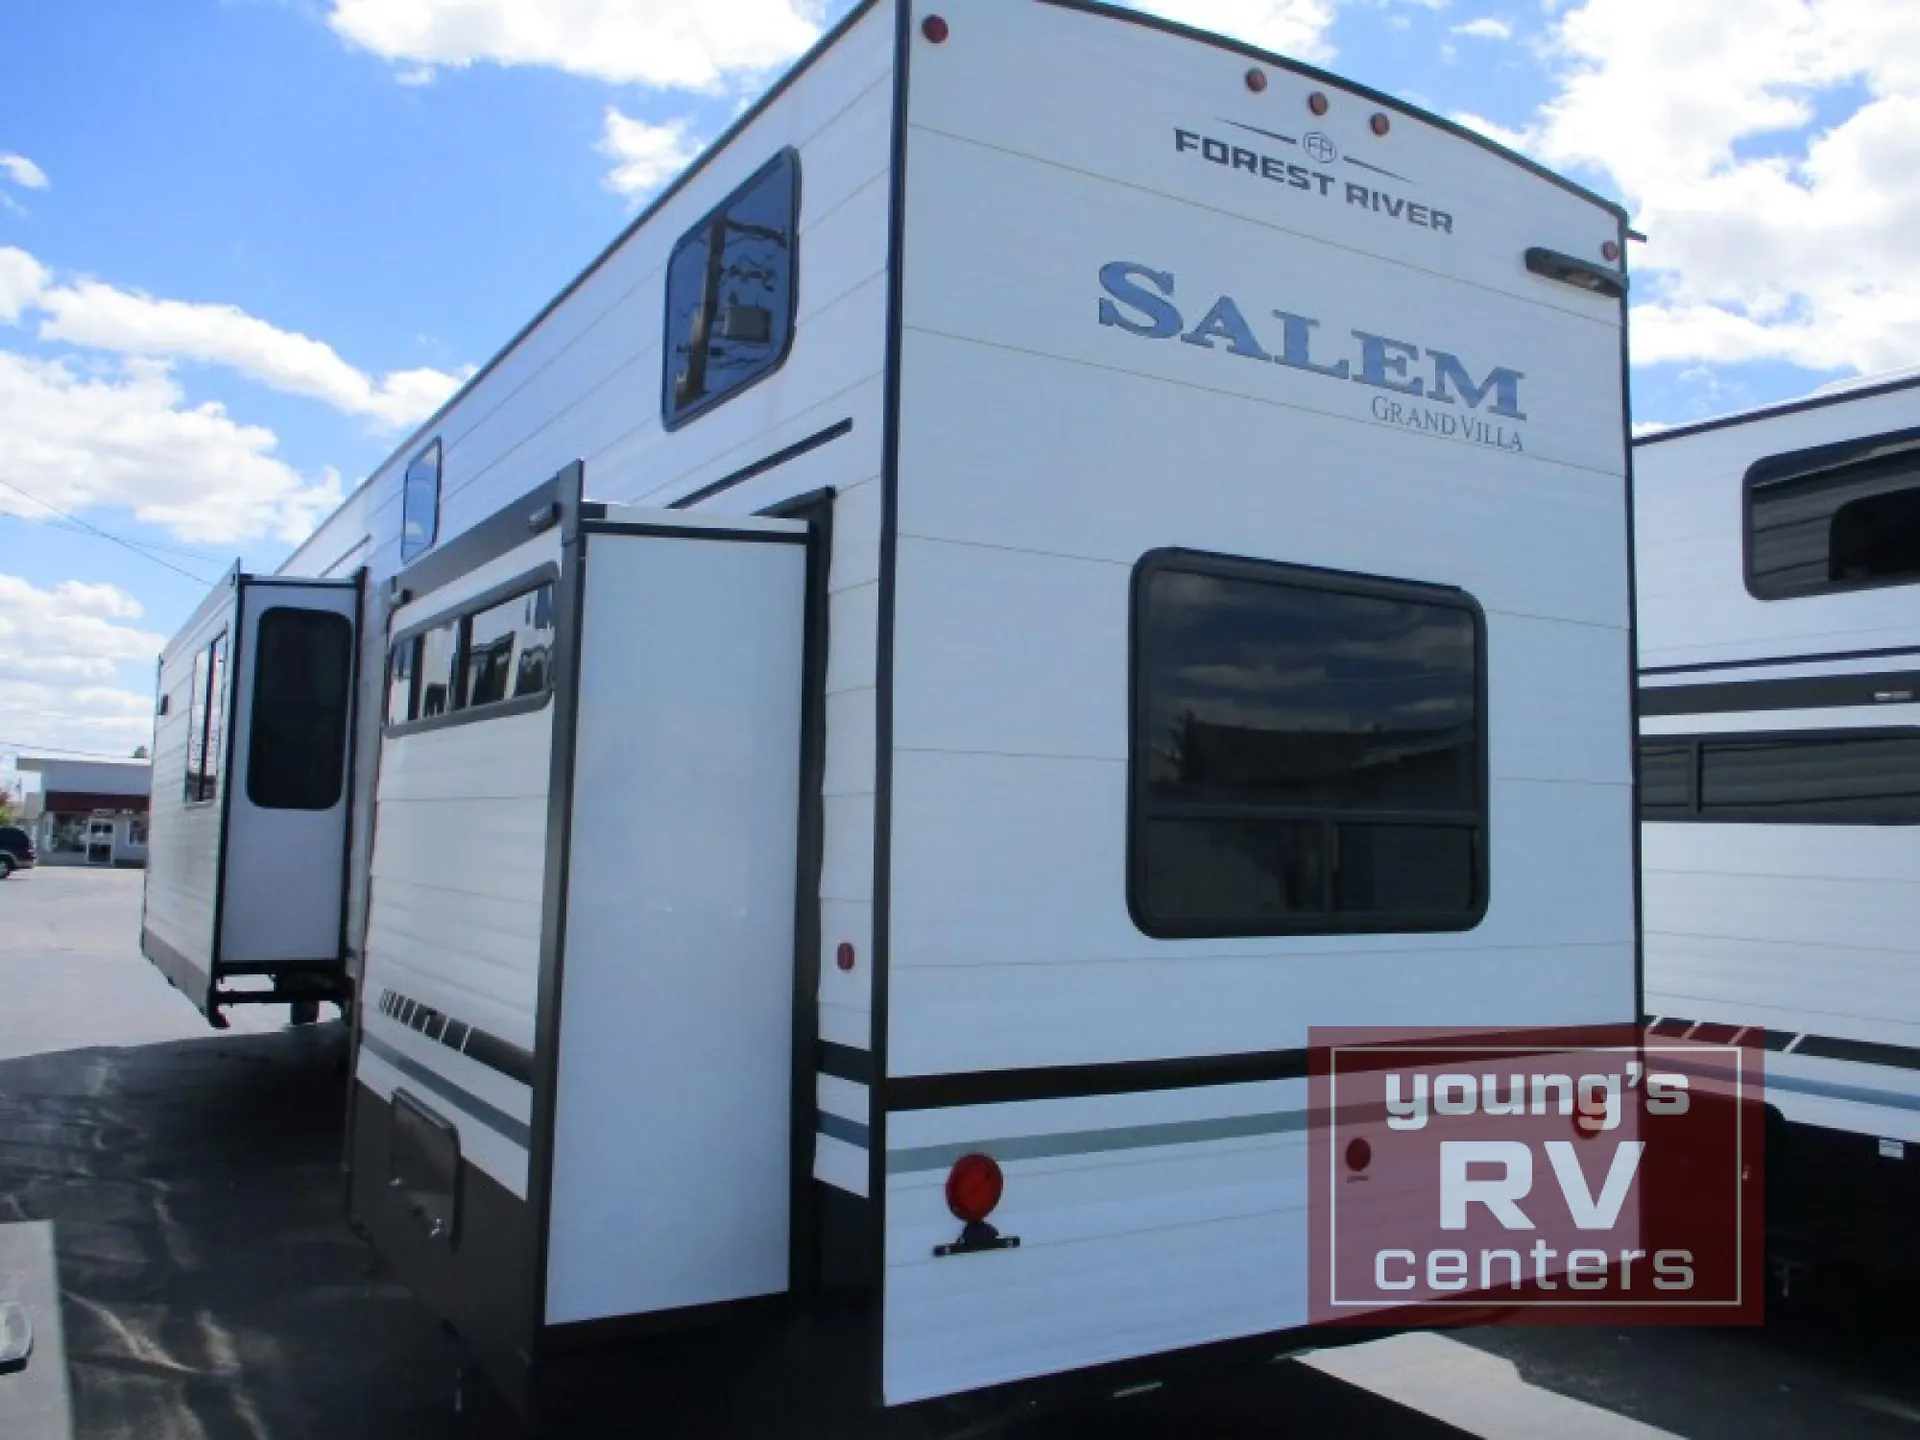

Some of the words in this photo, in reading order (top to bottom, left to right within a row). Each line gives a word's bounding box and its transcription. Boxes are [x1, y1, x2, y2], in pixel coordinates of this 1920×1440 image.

[1174, 128, 1335, 197] FOREST
[1345, 181, 1454, 234] RIVER
[1098, 260, 1527, 421] SALEM
